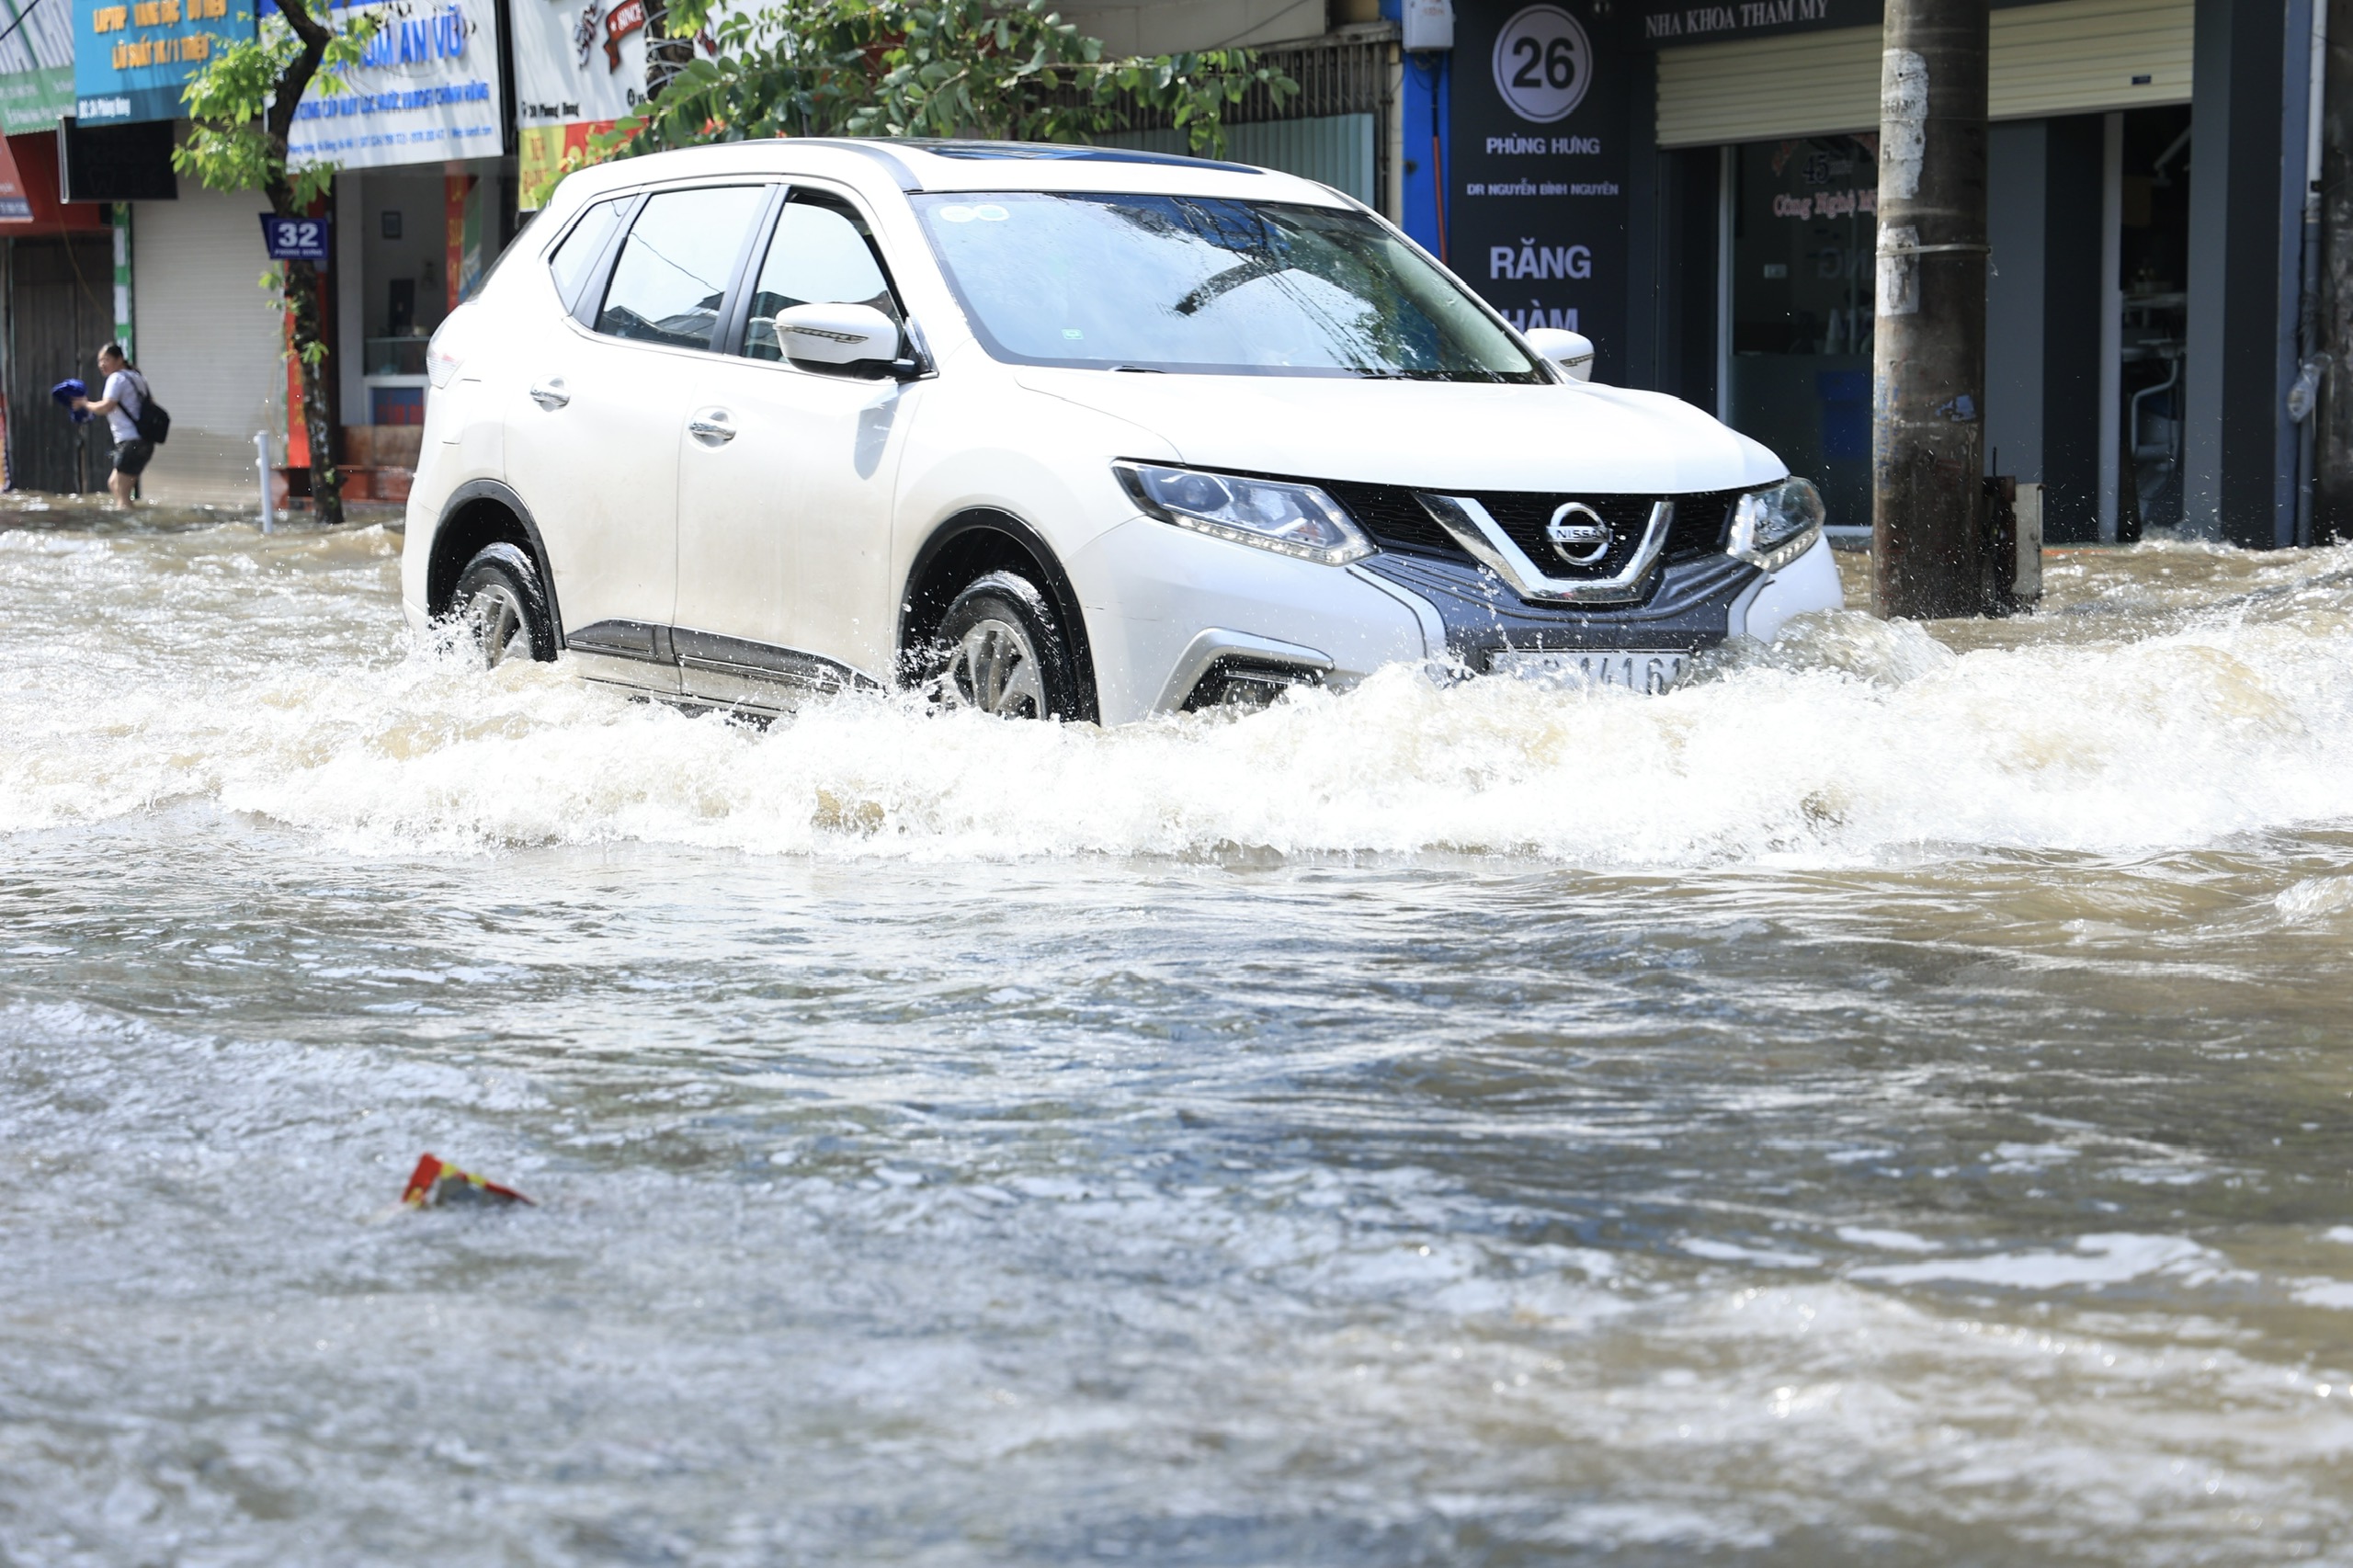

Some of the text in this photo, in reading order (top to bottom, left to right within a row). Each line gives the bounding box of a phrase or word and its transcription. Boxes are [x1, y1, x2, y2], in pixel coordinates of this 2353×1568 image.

[616, 3, 642, 31] SINCE
[1645, 15, 1682, 38] NHA
[1686, 6, 1736, 34] KHOA
[1512, 37, 1575, 90] 26
[1486, 133, 1600, 154] PHÙNG HƯNG
[1466, 183, 1485, 196] DR
[278, 222, 319, 248] 32
[1490, 237, 1591, 279] RĂNG
[1556, 529, 1607, 540] NISSAN
